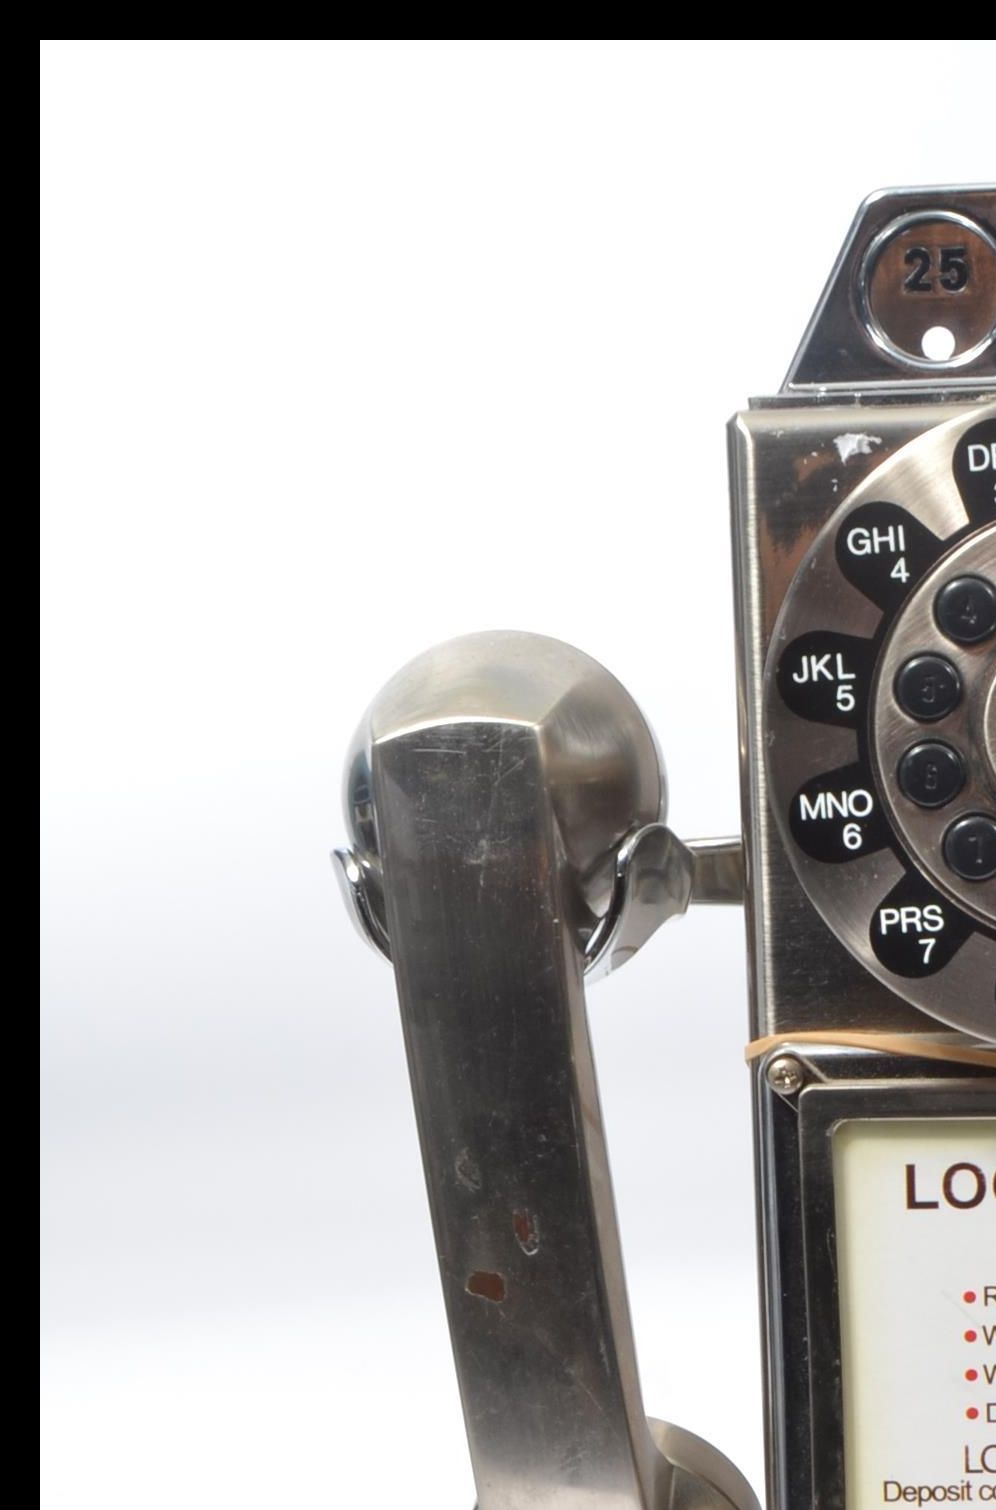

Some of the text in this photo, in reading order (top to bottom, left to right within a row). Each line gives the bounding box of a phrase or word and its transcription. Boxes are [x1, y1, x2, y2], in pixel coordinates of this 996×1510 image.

[902, 246, 969, 293] 25
[846, 525, 906, 555] GHI
[890, 558, 911, 583] 4
[792, 653, 856, 683] JKL
[836, 686, 856, 712] 5
[799, 789, 874, 821] MNO
[842, 823, 863, 850] 6
[879, 905, 945, 935] PRS
[918, 938, 937, 964] 7
[883, 1480, 973, 1507] Deposit
